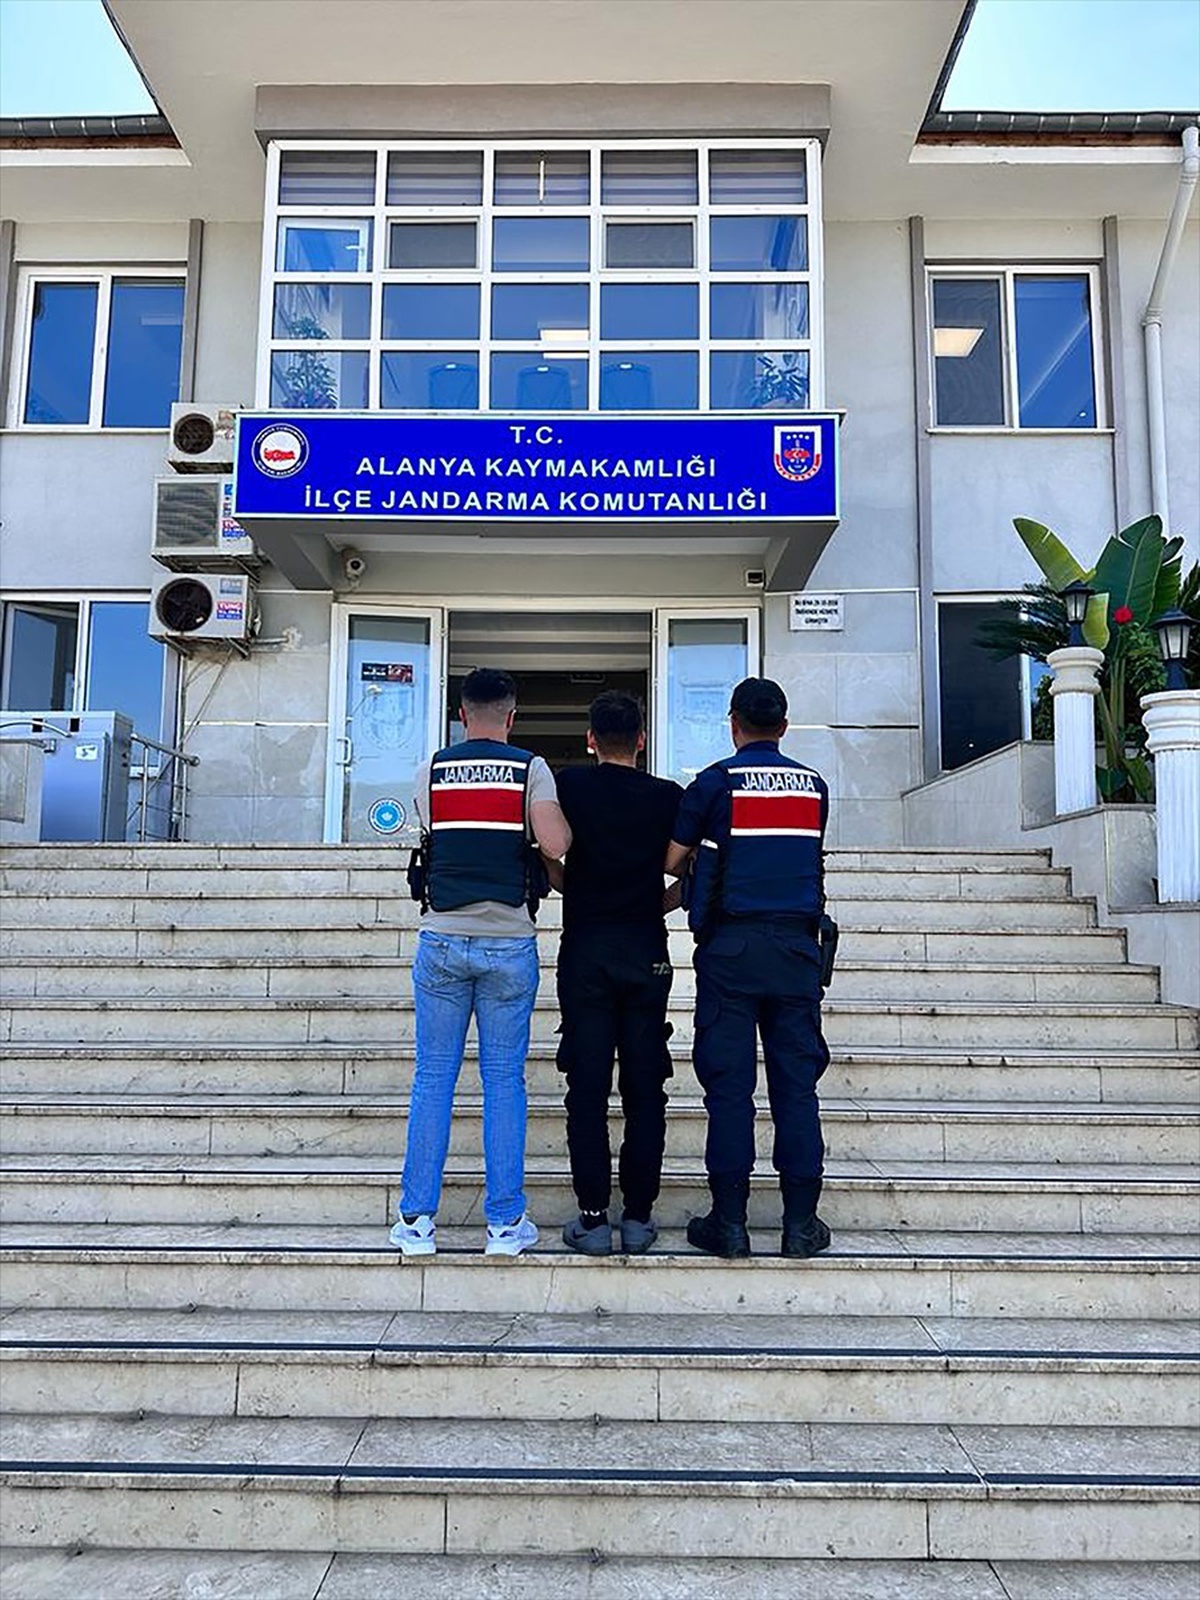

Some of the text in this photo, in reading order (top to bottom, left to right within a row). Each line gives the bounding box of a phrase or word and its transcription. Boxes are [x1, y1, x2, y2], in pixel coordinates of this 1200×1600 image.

[510, 426, 562, 444] T.C.
[356, 455, 714, 477] ALANYA KAYMAKAMLIĞI
[305, 485, 765, 511] İLÇE JANDARMA KOMUTANLIĞI
[440, 766, 514, 784] JANDARMA
[741, 772, 815, 791] JANDARMA
